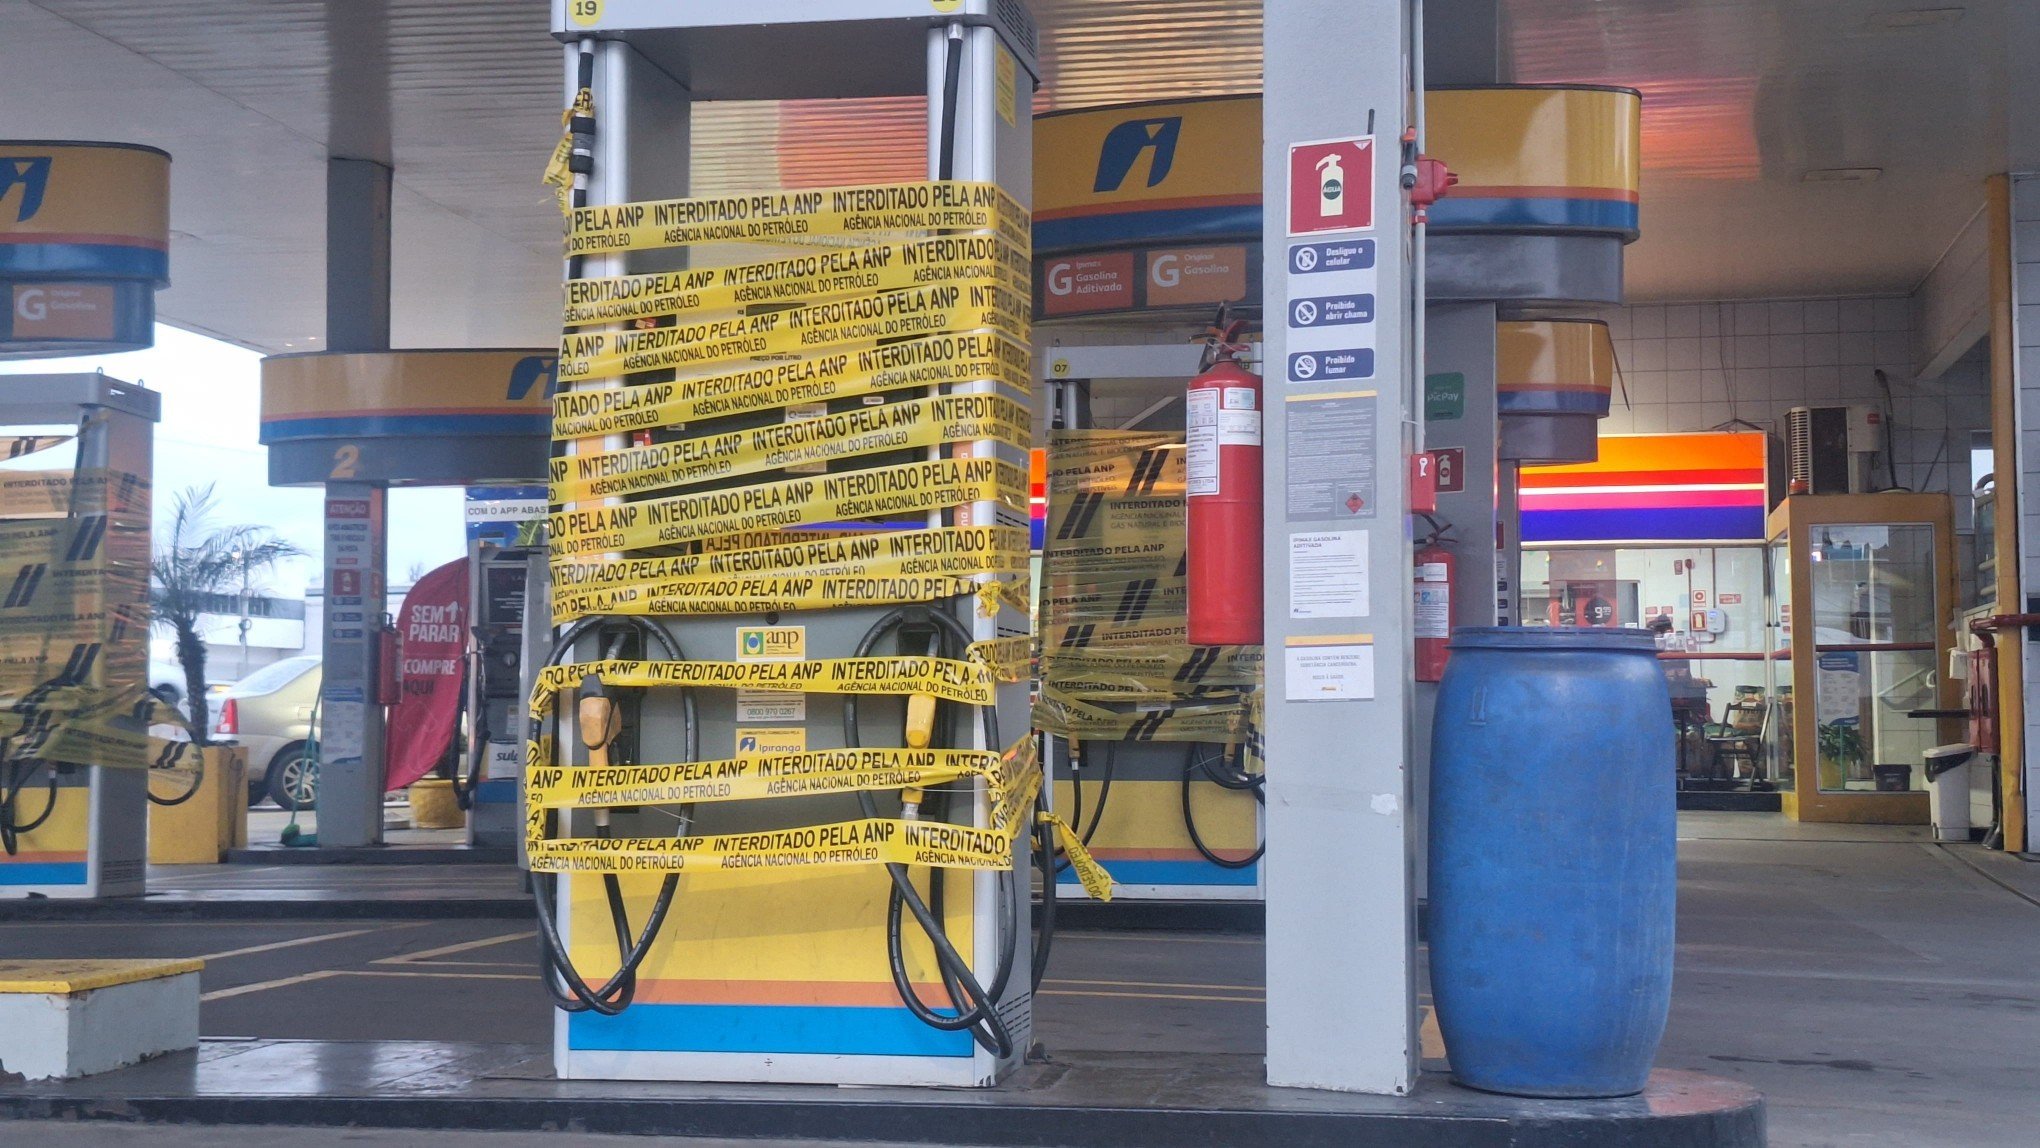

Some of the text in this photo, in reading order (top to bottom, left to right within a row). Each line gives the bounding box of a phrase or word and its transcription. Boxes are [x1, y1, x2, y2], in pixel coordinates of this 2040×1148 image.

[576, 1, 597, 16] 19
[575, 209, 612, 232] PELA
[616, 206, 644, 228] ANP
[655, 199, 747, 225] INTERDITADO
[752, 195, 789, 217] PELA
[794, 192, 822, 214] ANP
[833, 187, 927, 212] INTERDITADO
[933, 185, 969, 207] PELA
[974, 186, 995, 207] ANP
[572, 209, 987, 250] DO PETRÓLEO AGÊNCIA NACIONAL DO PETRÓLEO AGÊNCIA NACIONAL DO PETRÓLEO
[1326, 248, 1356, 256] Desligue
[1076, 271, 1117, 282] Gasolina
[1152, 255, 1179, 288] G
[1185, 264, 1229, 275] Gasolina
[1048, 263, 1072, 296] G
[1076, 283, 1122, 294] Aditivada
[16, 289, 46, 321] G
[1326, 301, 1355, 310] Proibido
[576, 335, 604, 358] ANP
[615, 326, 705, 354] INTERDITADO
[710, 320, 745, 339] PELA
[750, 314, 779, 333] ANP
[790, 297, 883, 328] INTERDITADO
[887, 291, 926, 315] PELA
[930, 286, 959, 309] ANP
[623, 314, 946, 370] AGÊNCIA NACIONAL DO PETRÓLEO AGÊNCIA NACIONAL DO PETRÓLEO
[1325, 355, 1355, 364] Proibido
[1054, 364, 1067, 372] 07
[1325, 366, 1346, 374] fumar
[1427, 392, 1459, 402] PicPay
[578, 403, 921, 480] INTERDITADO PELA ANP INTERDITADO PELA ANP
[329, 445, 360, 478] 2
[1066, 464, 1115, 476] PELA ANP
[4, 479, 66, 488] INTERDITADO
[570, 461, 992, 535] PELA ANP INTERDITADO PELA ANP INTERDITADO PELA ANP
[1110, 500, 1179, 509] INTERDITADO
[468, 506, 518, 515] COM O APP
[567, 488, 980, 552] DO PETRÓLEO AGÊNCIA NACIONAL DO PETRÓLEO AGÊNCIA NACIONAL DO PETRÓLEO
[1115, 545, 1142, 554] PELA
[1143, 543, 1164, 553] ANP
[411, 605, 444, 623] SEM
[409, 624, 459, 643] PARAR
[766, 631, 799, 649] anp
[1102, 627, 1171, 640] INTERDITADO
[404, 660, 455, 675] COMPRE
[760, 744, 800, 753] Ipiranga
[531, 752, 935, 789] ANP INTERDITADO PELA ANP INTERDITADO PELA ANP
[578, 770, 921, 805] AGÊNCIA NACIONAL DO PETRÓLEO AGÊNCIA NACIONAL DO PETRÓLEO
[628, 839, 667, 851] PELA
[671, 838, 704, 851] ANP
[714, 831, 815, 852] INTERDITADO
[819, 825, 859, 847] PELA
[863, 822, 894, 843] ANP
[905, 825, 1005, 854] INTERDITADO
[531, 853, 570, 869] AGÊNCIA
[572, 855, 618, 870] NACIONAL
[620, 856, 633, 869] DO
[636, 852, 684, 869] PETRÓLEO
[721, 853, 762, 868] AGÊNCIA
[764, 850, 811, 868] NACIONAL
[814, 851, 827, 861] DO
[829, 845, 878, 861] PETRÓLEO
[915, 849, 954, 863] AGÊNCIA
